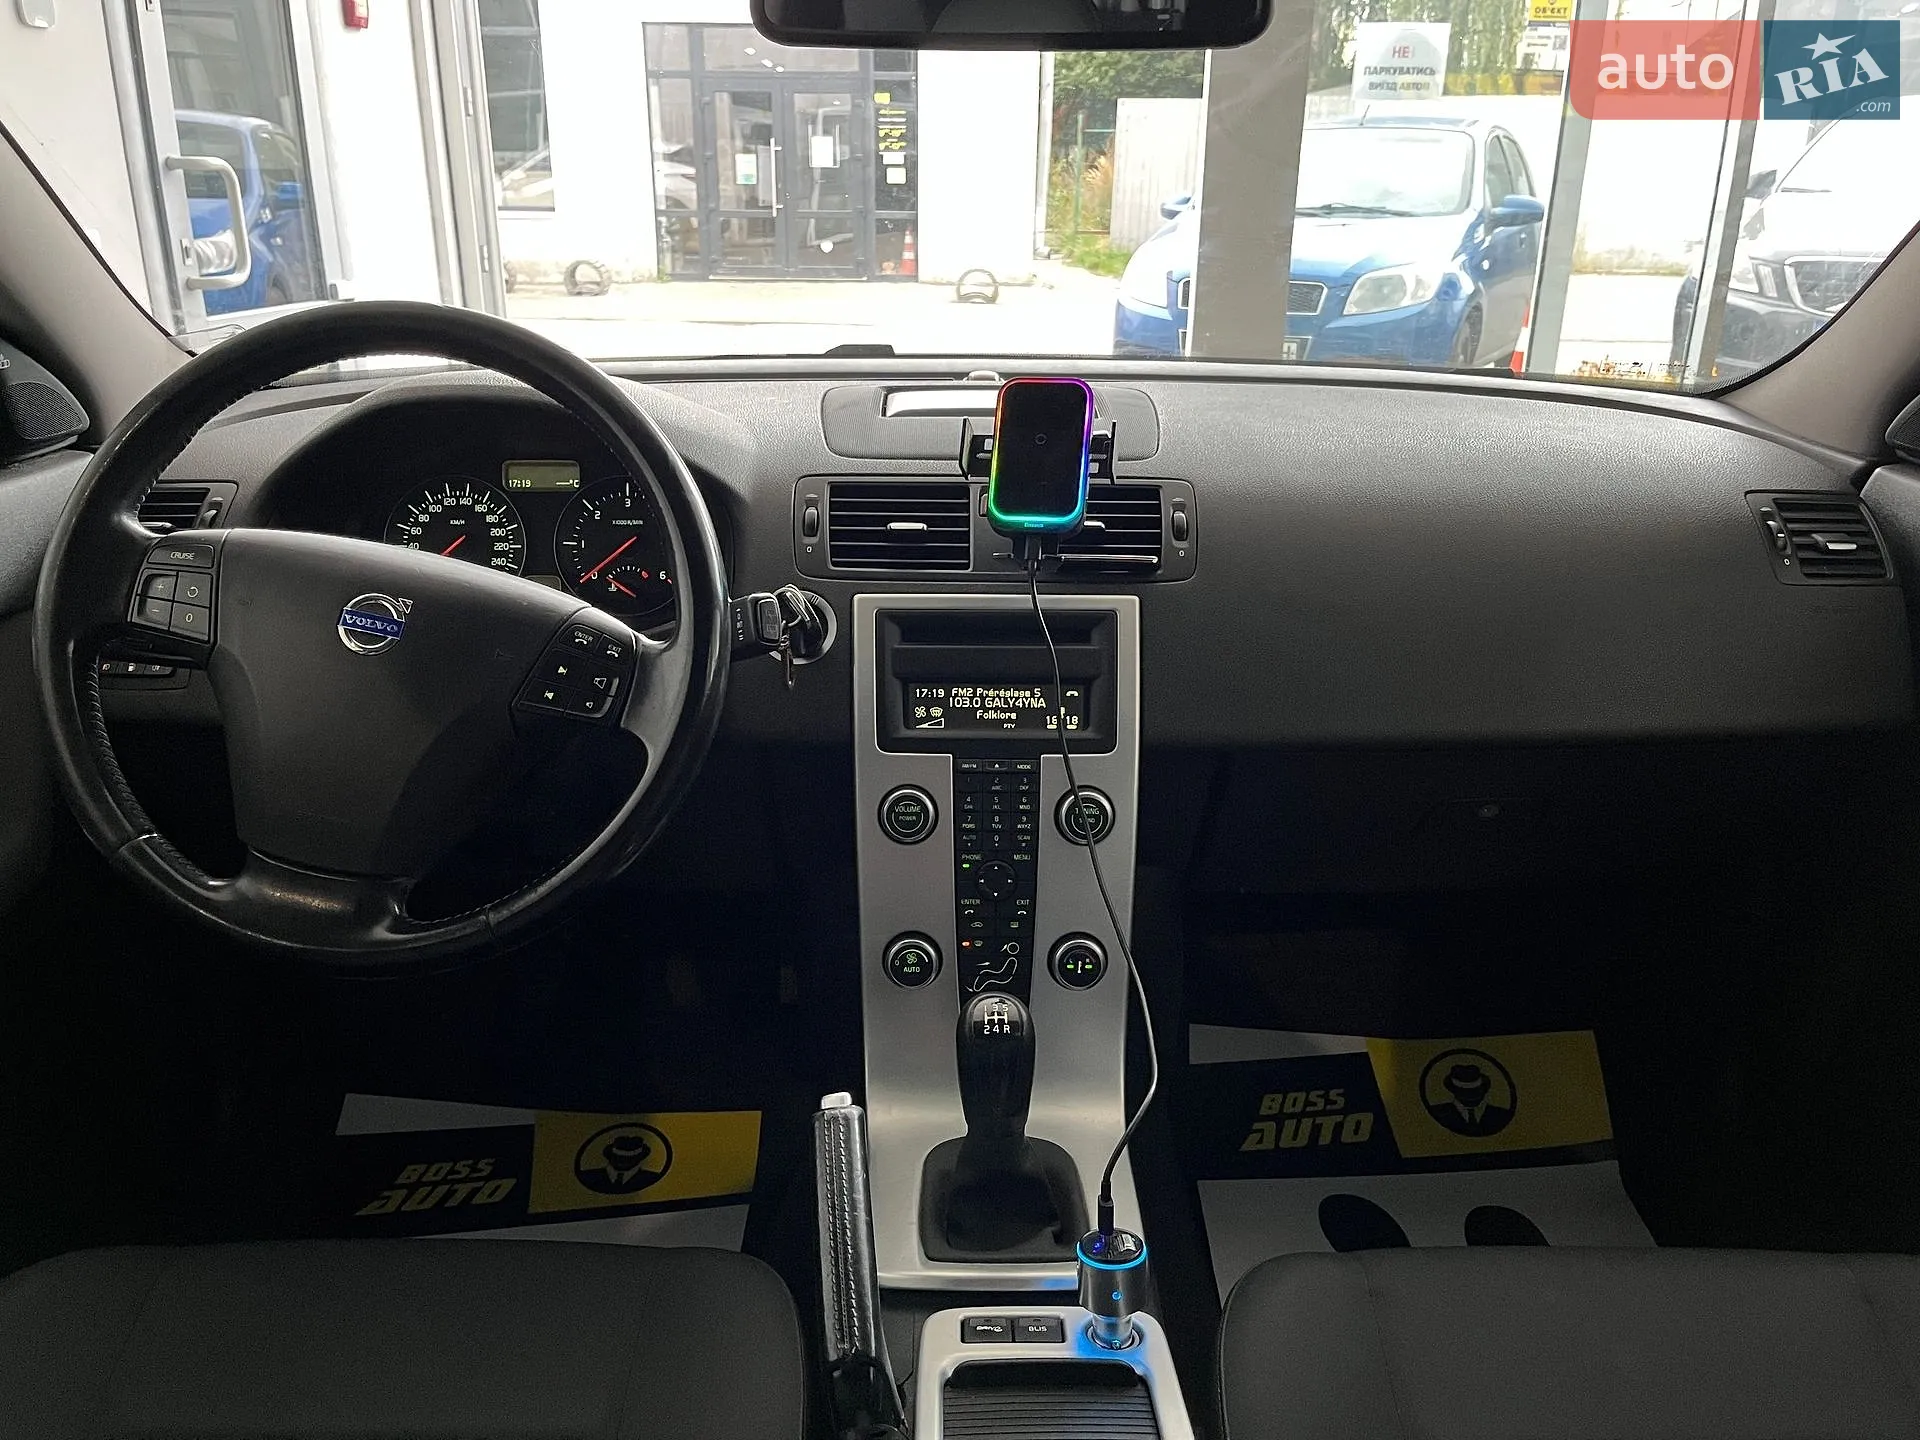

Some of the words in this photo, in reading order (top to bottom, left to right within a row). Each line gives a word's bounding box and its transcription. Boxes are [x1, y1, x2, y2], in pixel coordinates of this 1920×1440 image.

[1363, 66, 1436, 76] ПАРКУВАТИСЬ
[508, 479, 532, 488] 17:19
[444, 498, 456, 506] 120
[459, 498, 472, 506] 140
[428, 504, 442, 513] 100
[474, 504, 488, 513] 160
[418, 514, 430, 522] 80
[485, 514, 499, 523] 180
[410, 527, 422, 535] 60
[490, 528, 506, 536] 200
[407, 542, 420, 550] 40
[493, 542, 510, 551] 220
[170, 551, 195, 560] CRUISE
[490, 557, 507, 566] 240
[344, 613, 399, 633] VOLVO
[915, 688, 945, 698] 17:19
[951, 687, 974, 697] FM2
[949, 697, 981, 708] 103.0
[984, 697, 1047, 708] GALY4YNA
[976, 709, 1017, 720] Folklore
[1066, 715, 1079, 725] 18
[894, 805, 921, 813] VOLUME
[1258, 1088, 1346, 1117] BOSS
[1238, 1112, 1374, 1152] AUTO
[393, 1158, 497, 1185] BOSS
[353, 1177, 518, 1217] AUTO
